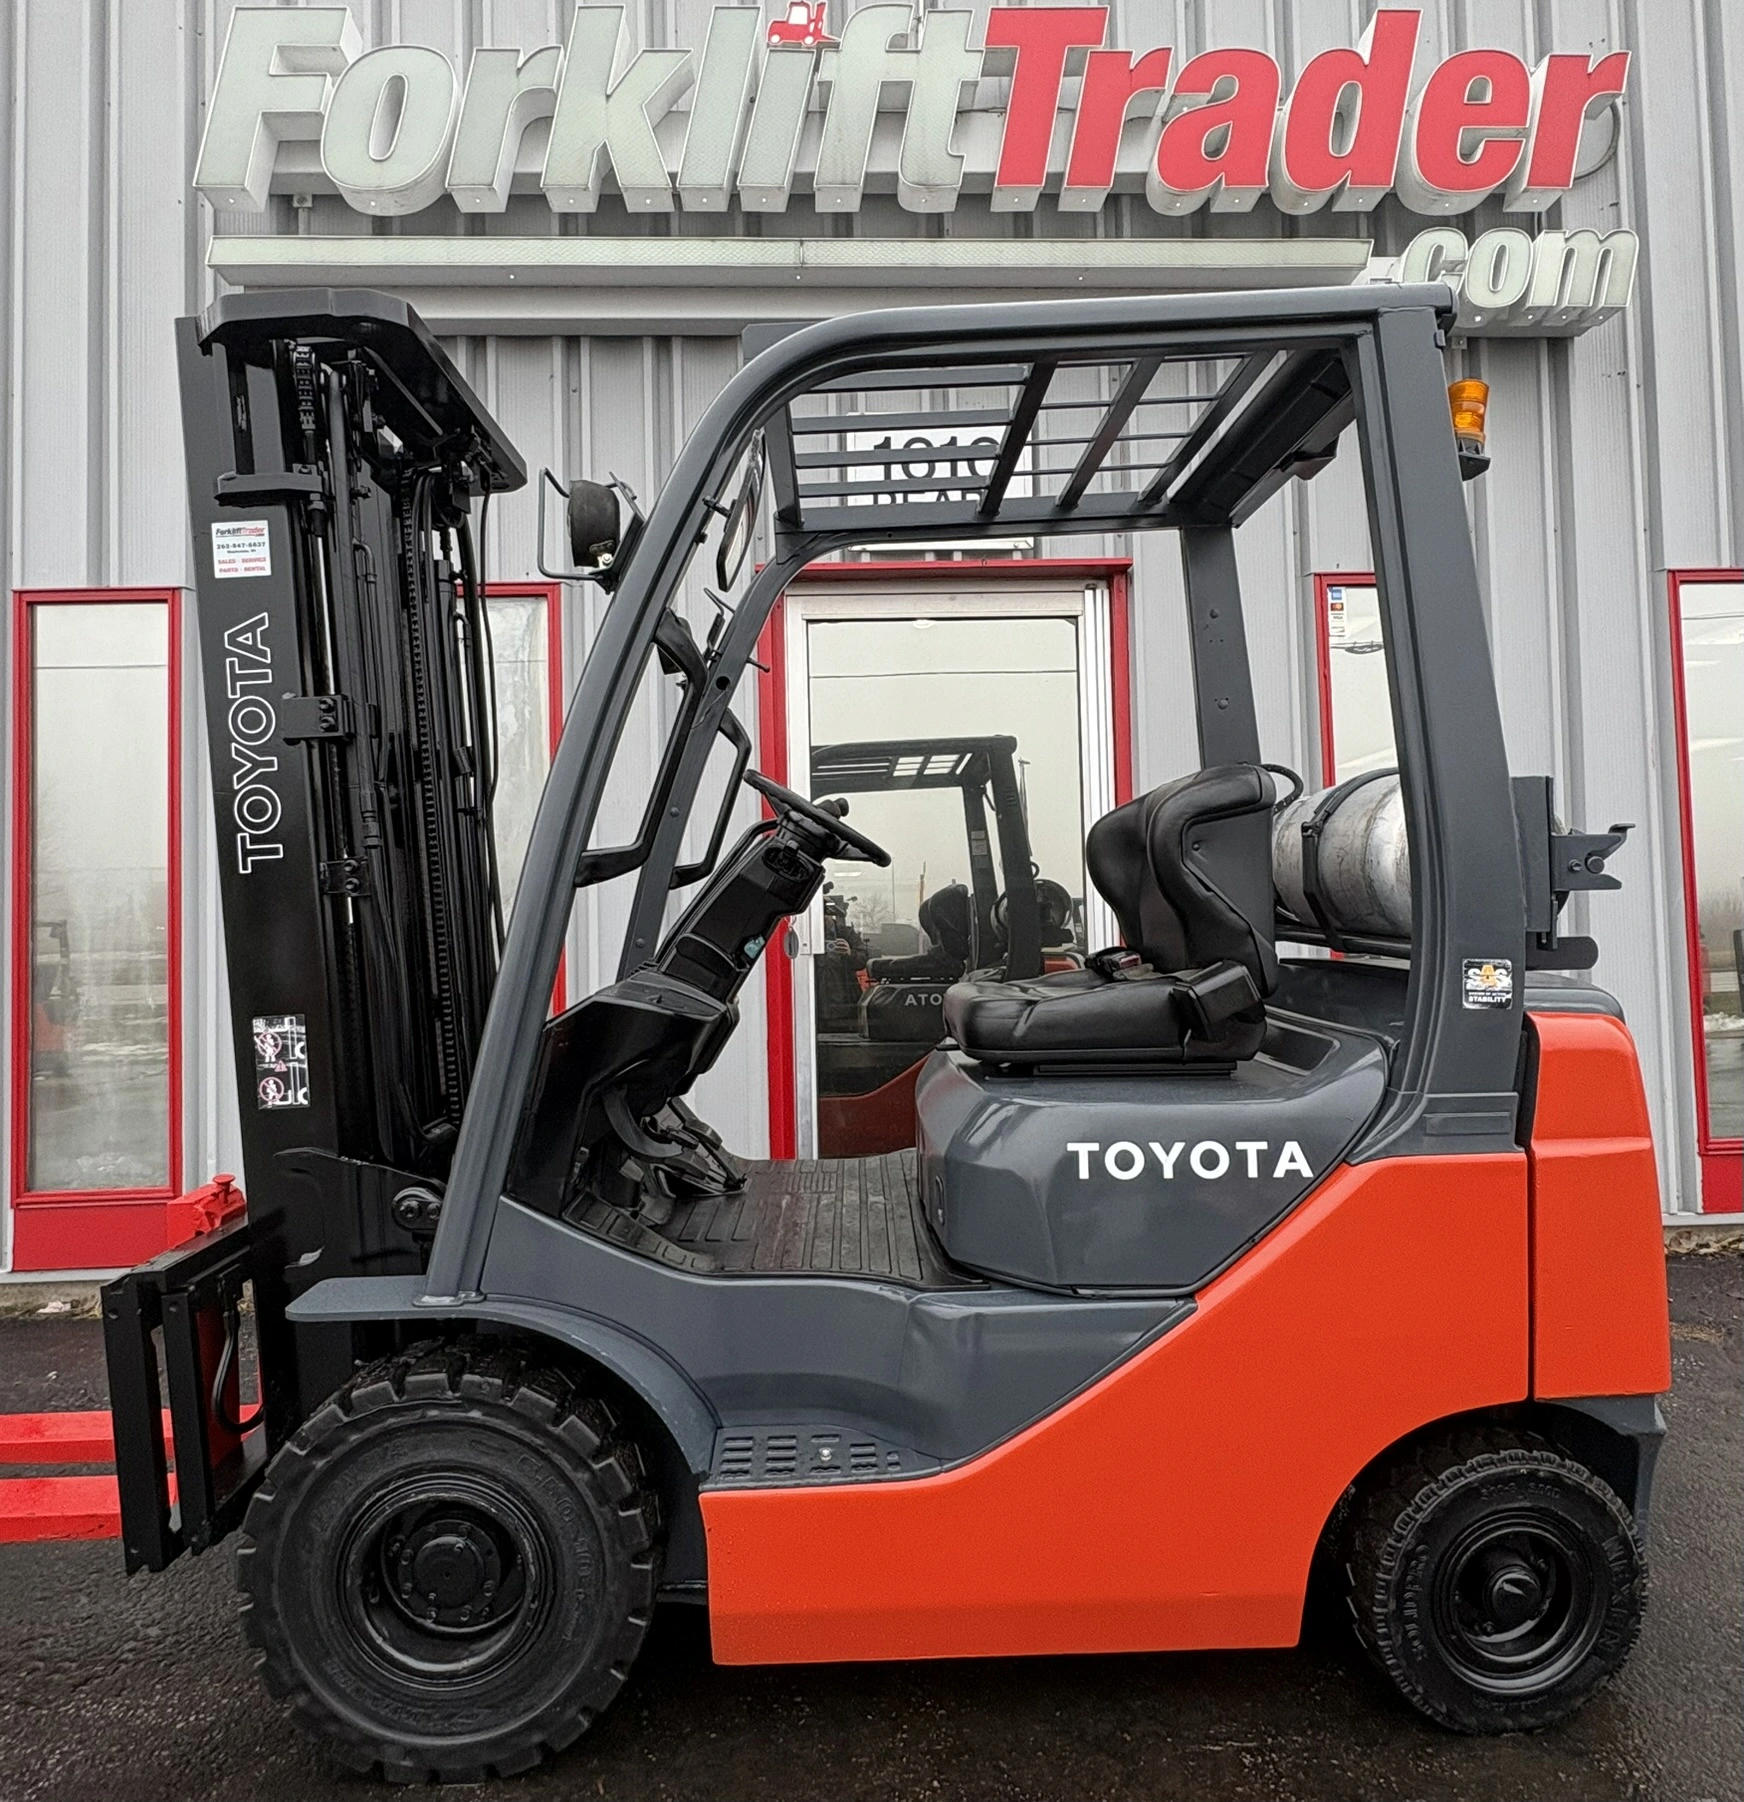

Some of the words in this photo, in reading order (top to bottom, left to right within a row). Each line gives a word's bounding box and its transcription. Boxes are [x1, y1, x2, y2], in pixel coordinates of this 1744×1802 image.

[1370, 227, 1639, 308] com
[224, 612, 283, 874] TOYOTA
[1066, 1140, 1315, 1181] TOYOTA
